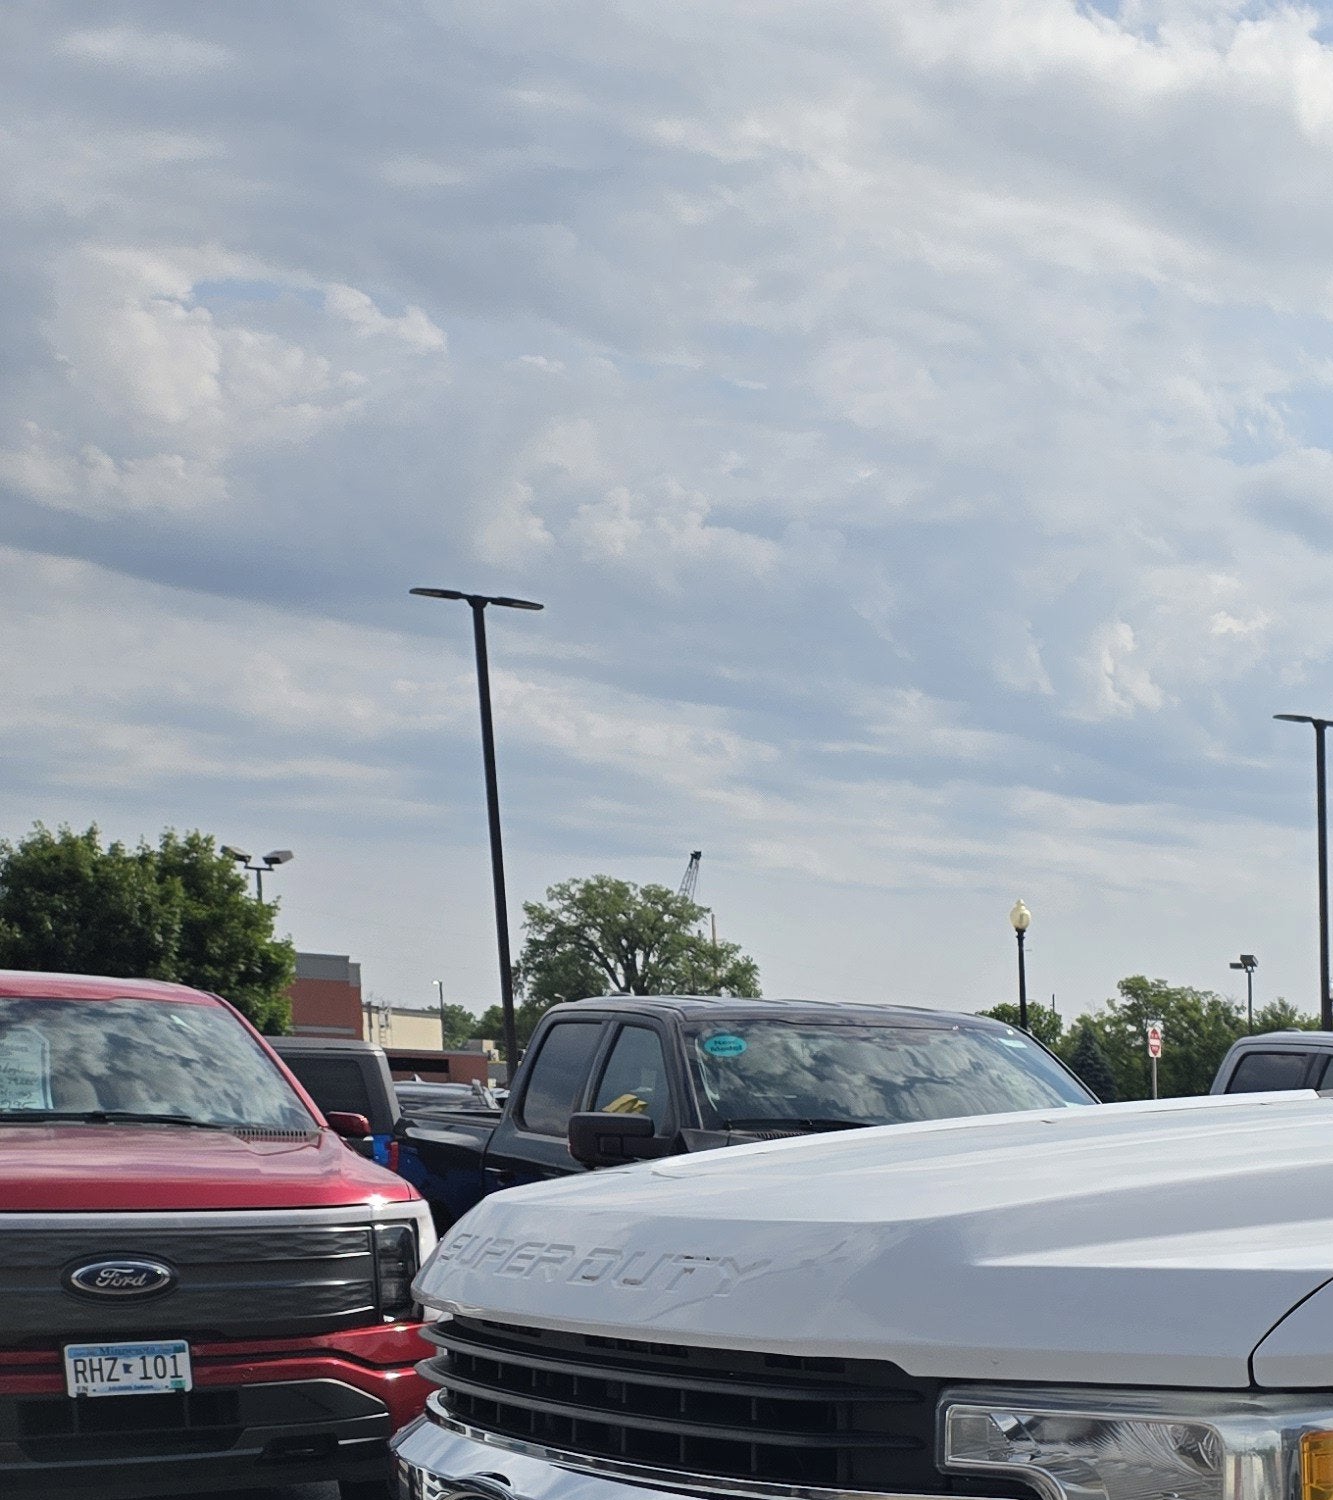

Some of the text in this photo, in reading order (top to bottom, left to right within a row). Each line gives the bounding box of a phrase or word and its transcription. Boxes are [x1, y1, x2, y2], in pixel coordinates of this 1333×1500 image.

[95, 1268, 147, 1287] Ford
[439, 1232, 773, 1298] SUPER DUTY
[73, 1354, 184, 1384] RHZ 101
